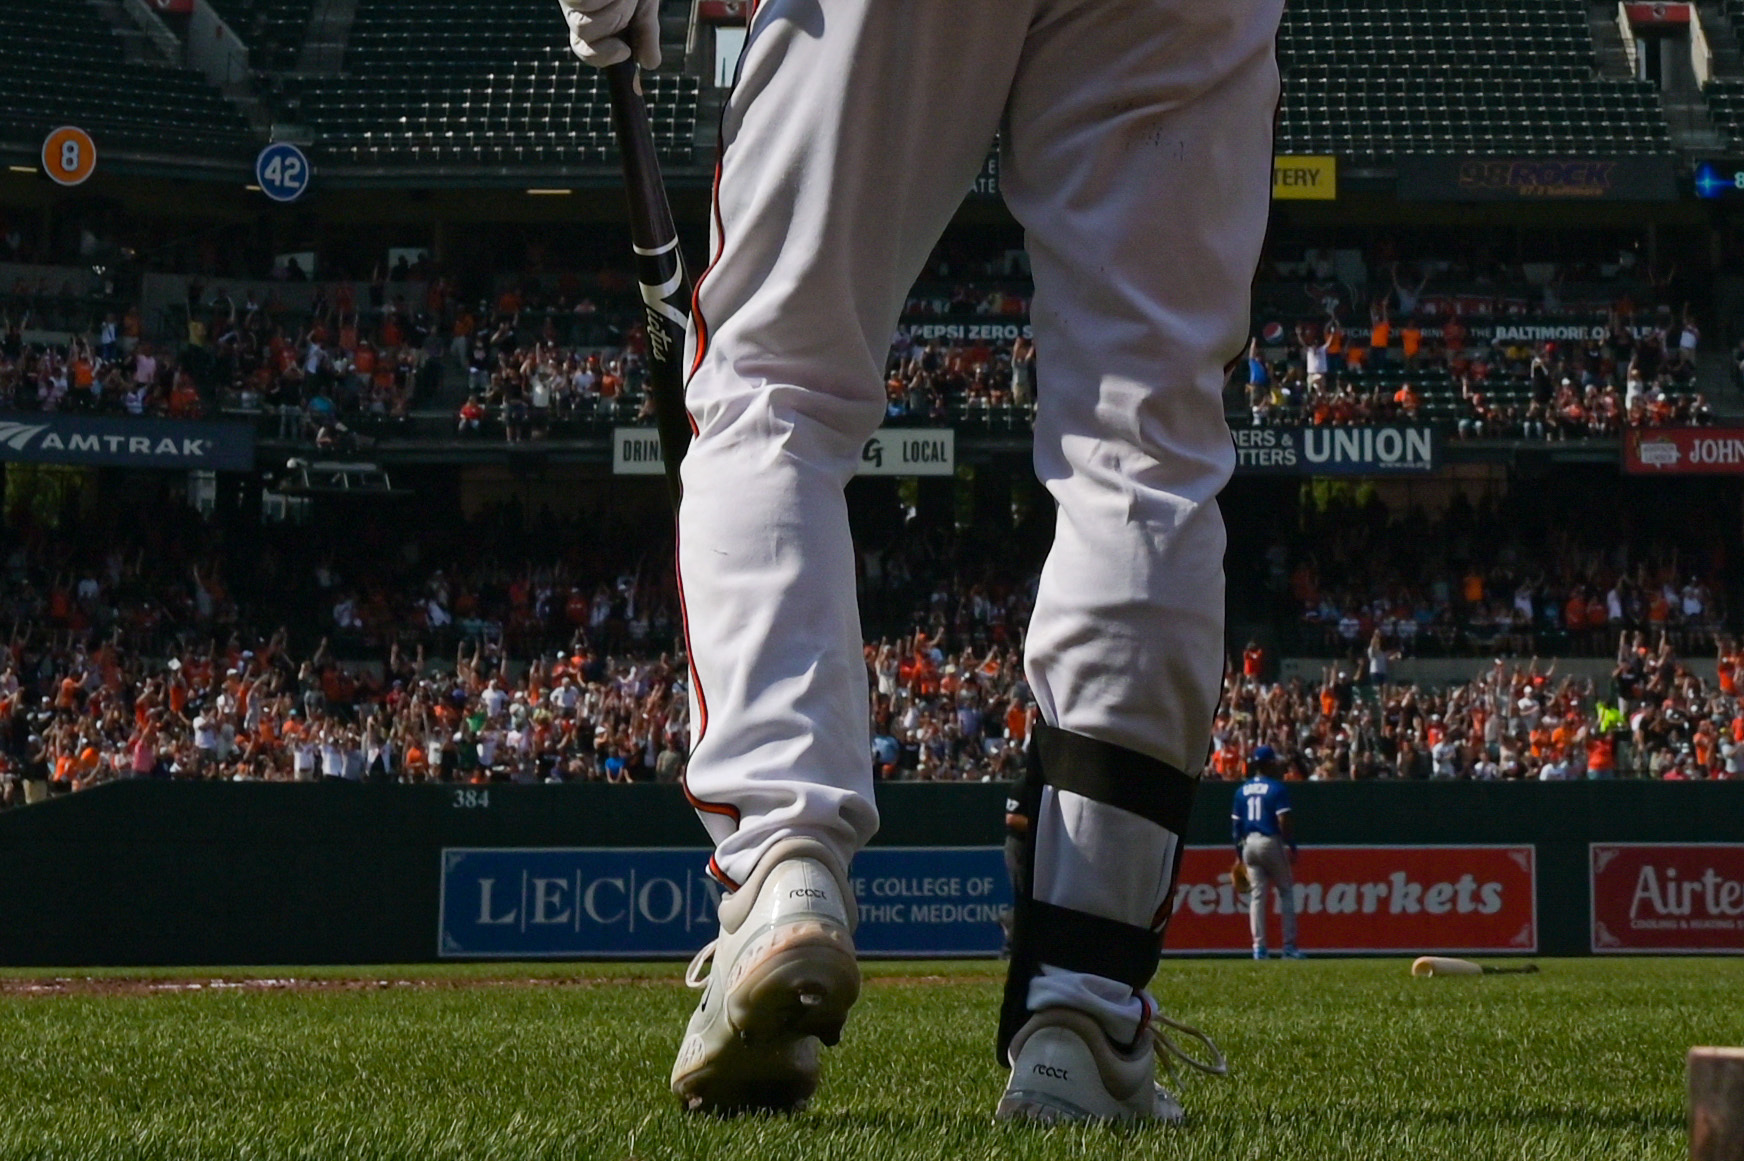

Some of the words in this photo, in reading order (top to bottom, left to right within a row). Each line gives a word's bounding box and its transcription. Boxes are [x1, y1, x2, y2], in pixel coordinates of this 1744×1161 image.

[61, 140, 79, 172] 8
[264, 156, 300, 189] 42
[911, 325, 964, 340] PEPSI
[968, 325, 1018, 340] ZERO
[40, 432, 205, 456] AMTRAK
[903, 441, 947, 463] LOCAL
[1304, 427, 1432, 463] UNION
[452, 789, 490, 809] 384
[1246, 796, 1262, 821] 11
[871, 878, 961, 897] COLLEGE
[966, 878, 994, 897] OF
[1273, 871, 1502, 915] markets
